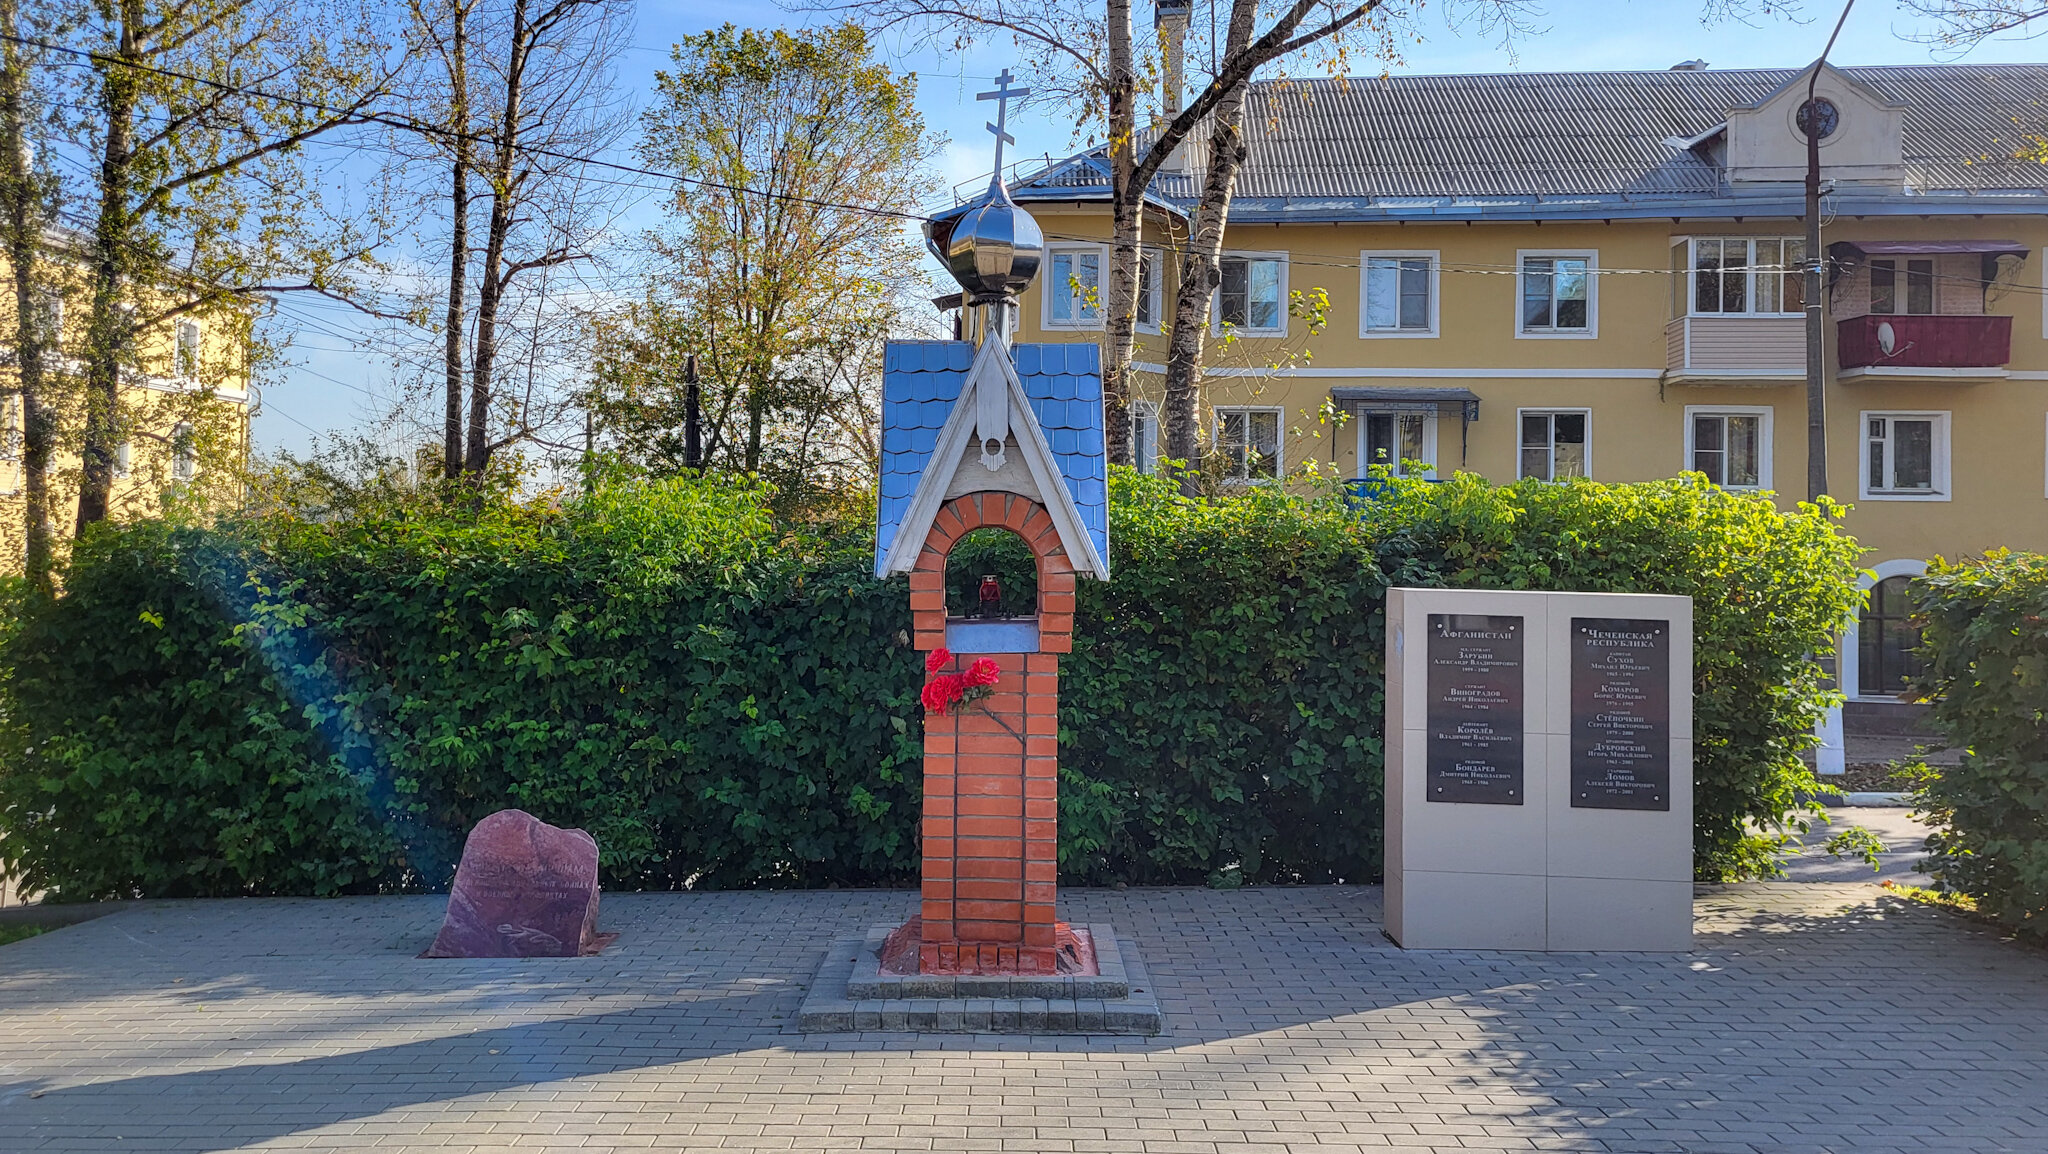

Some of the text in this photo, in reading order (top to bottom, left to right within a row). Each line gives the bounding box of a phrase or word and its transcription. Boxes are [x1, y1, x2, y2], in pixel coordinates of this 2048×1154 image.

[1440, 630, 1512, 639] АФГАНИСТАН
[1589, 630, 1652, 639] ЧЕЧЕНСКАЯ
[1586, 639, 1654, 647] РЕСПУБЛИКА
[1451, 688, 1500, 696] ВИНОГРАДОВ
[1601, 685, 1639, 693] КОМАРОВ
[1605, 773, 1634, 781] ЛОМОВ
